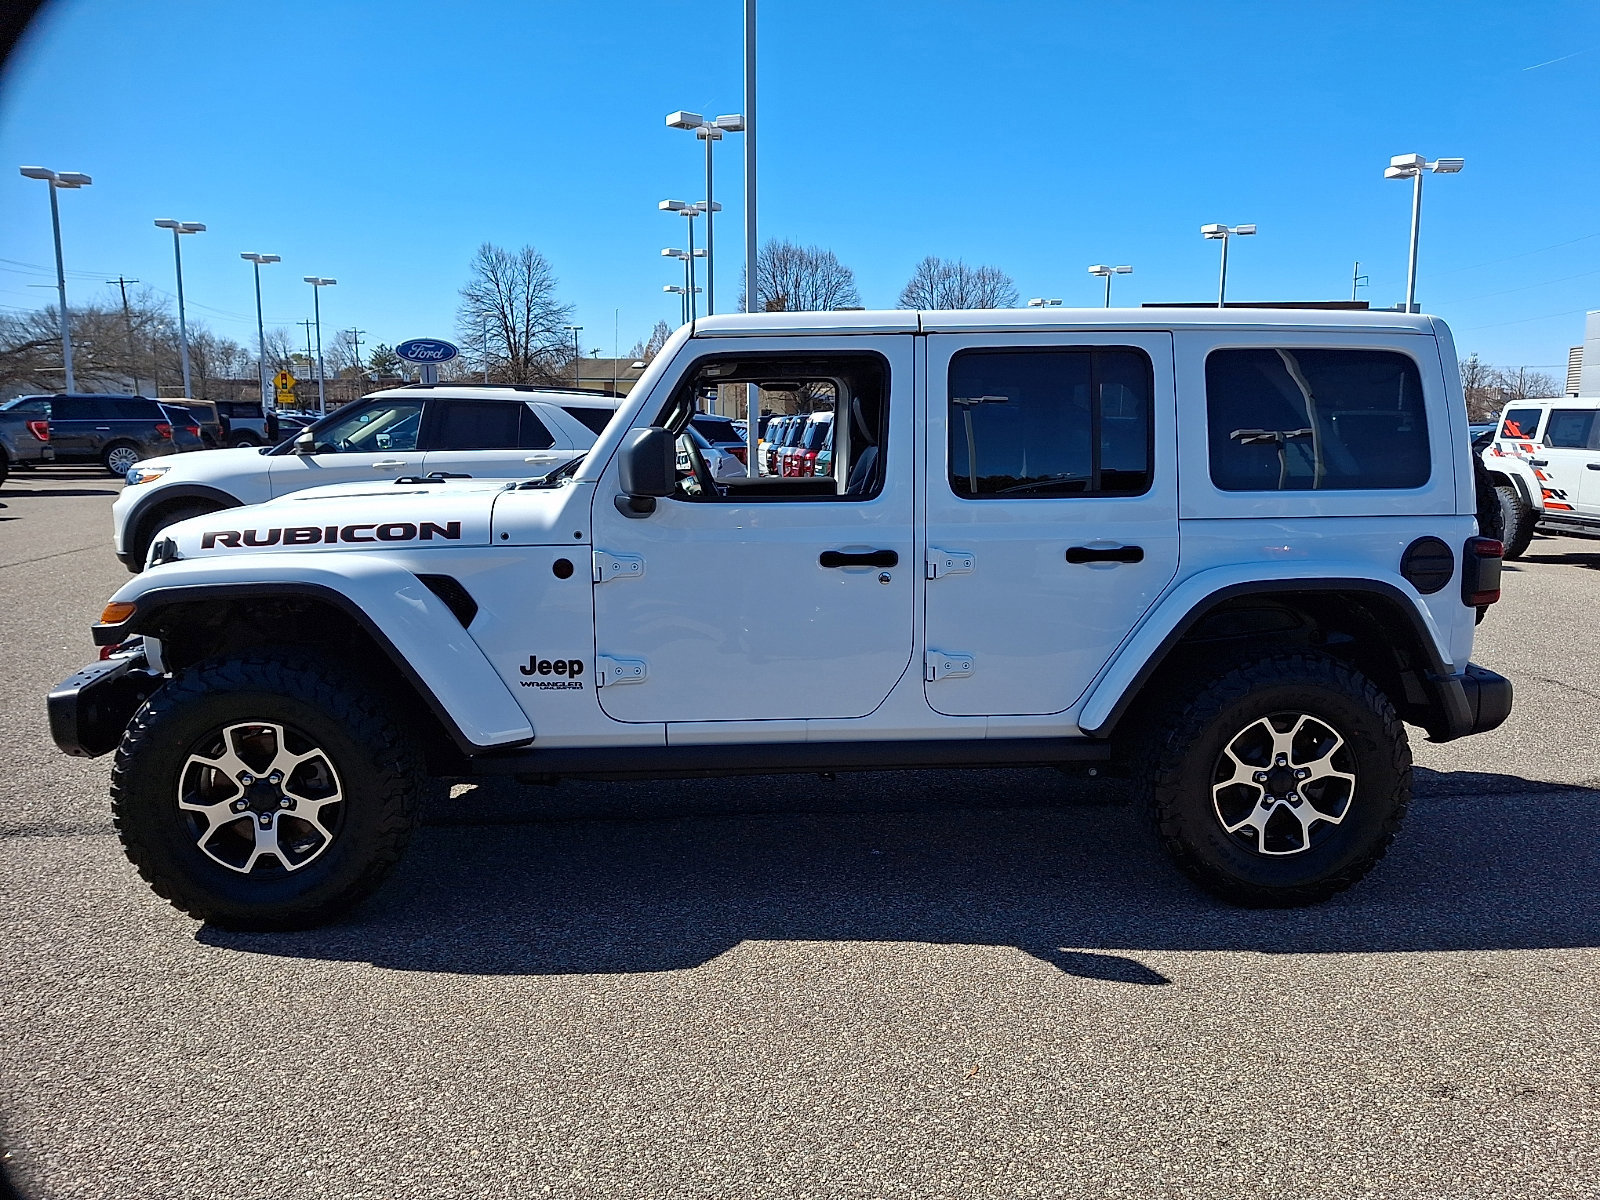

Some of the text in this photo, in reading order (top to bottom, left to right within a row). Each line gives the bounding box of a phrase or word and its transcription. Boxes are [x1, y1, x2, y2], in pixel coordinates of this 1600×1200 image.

[408, 343, 444, 359] Ford
[201, 521, 461, 549] RUBICON
[519, 655, 584, 679] Jeep
